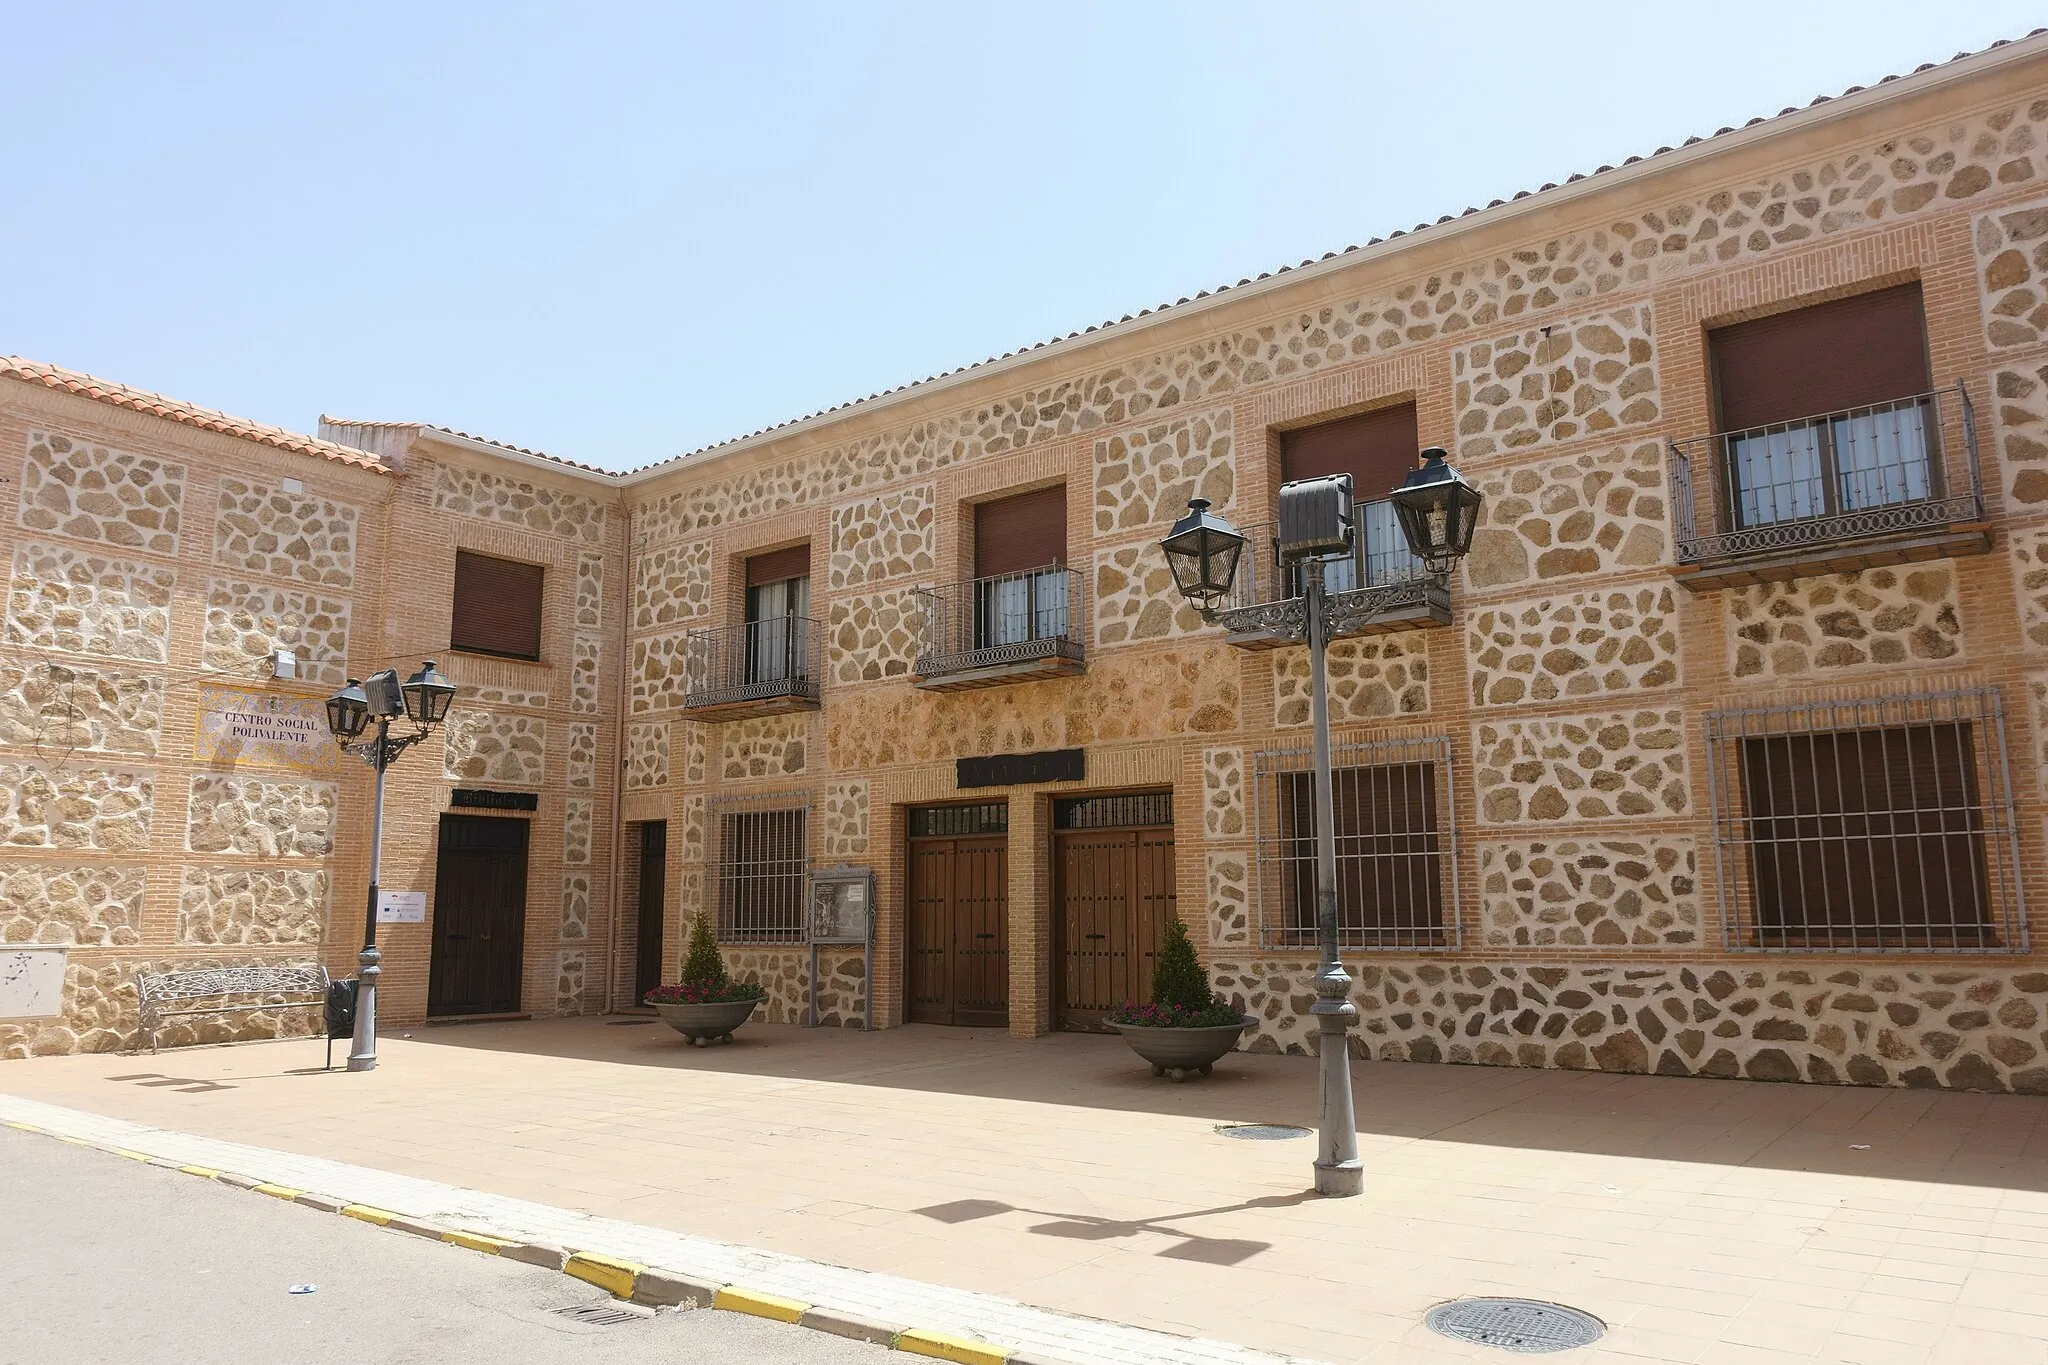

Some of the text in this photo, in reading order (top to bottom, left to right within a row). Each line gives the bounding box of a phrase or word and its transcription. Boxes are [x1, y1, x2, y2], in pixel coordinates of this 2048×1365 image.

[225, 712, 318, 731] CENTRO SOCIAL
[232, 726, 309, 743] POLIVALENTE
